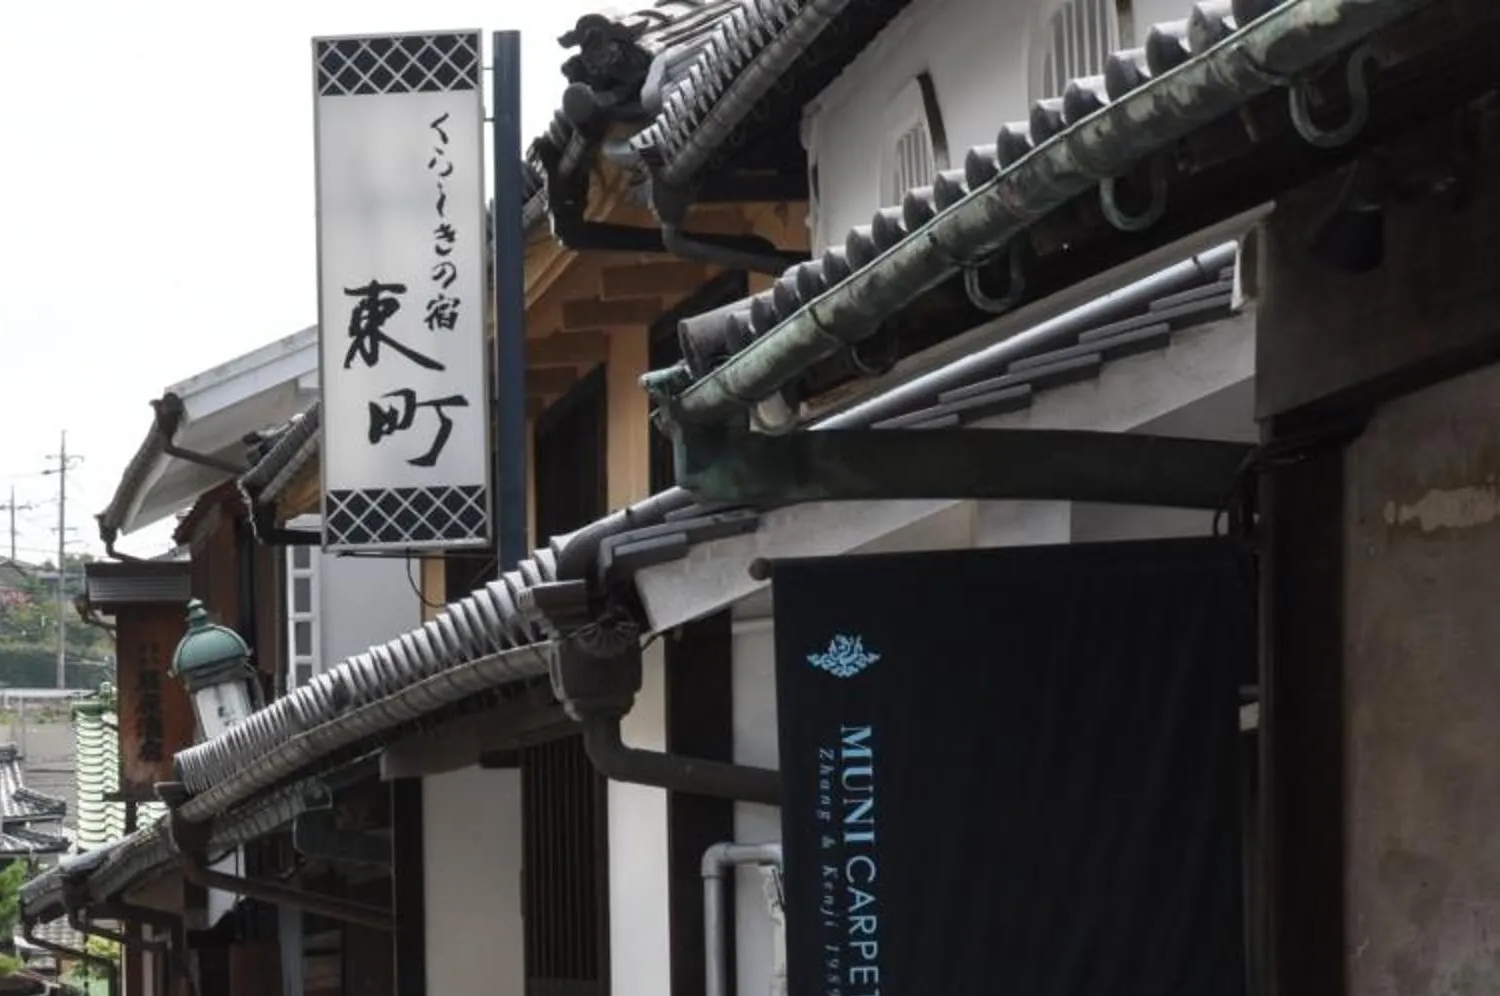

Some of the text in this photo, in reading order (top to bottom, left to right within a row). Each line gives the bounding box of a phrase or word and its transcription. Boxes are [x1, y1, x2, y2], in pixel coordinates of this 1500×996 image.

[343, 279, 469, 467] 東町
[818, 748, 835, 821] Zhang
[840, 726, 875, 843] MUNI
[820, 865, 839, 928] Kenji
